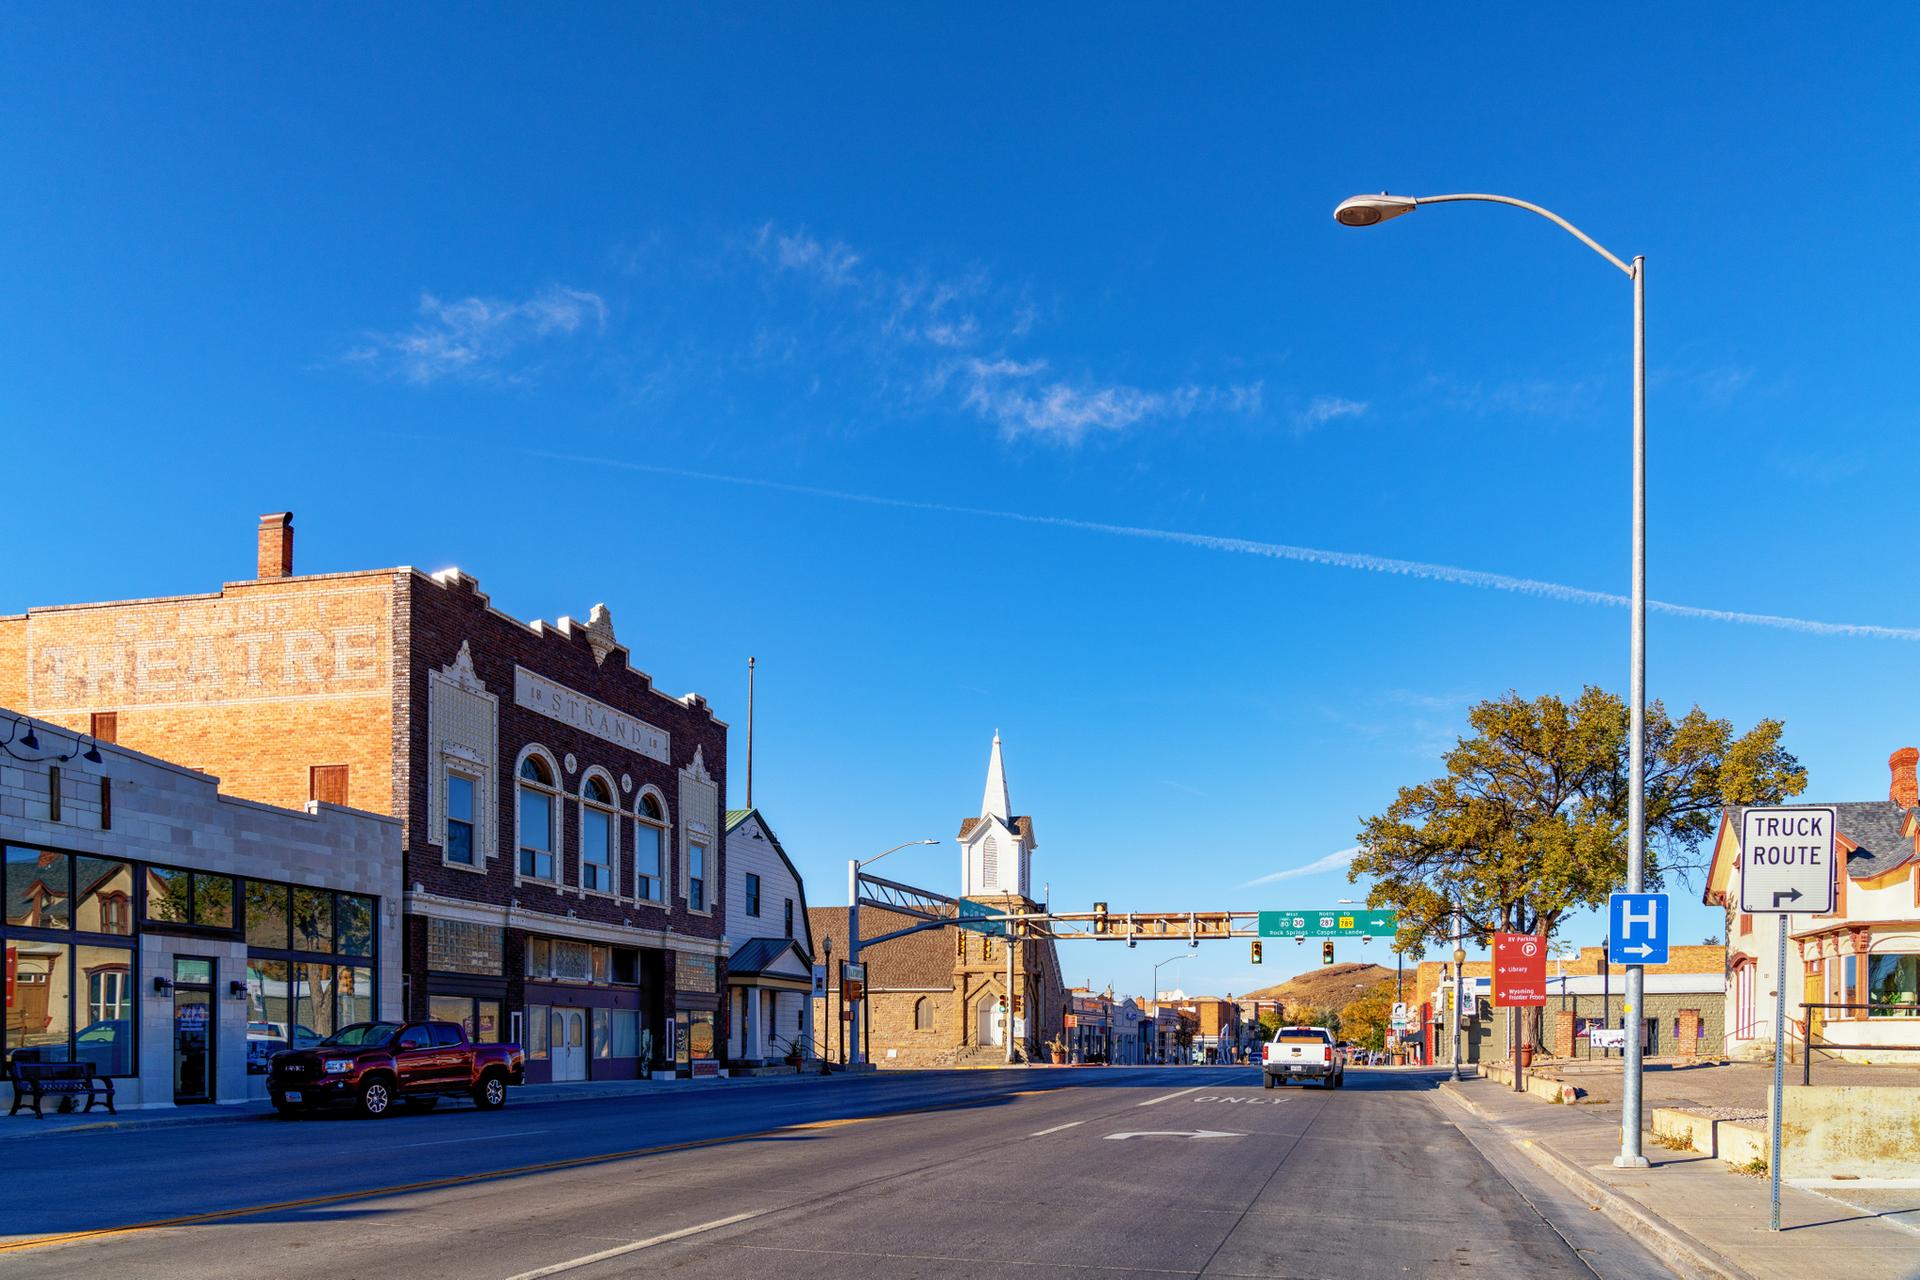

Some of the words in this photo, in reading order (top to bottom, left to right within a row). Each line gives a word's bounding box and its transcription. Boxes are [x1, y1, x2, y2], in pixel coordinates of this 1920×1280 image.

[41, 624, 379, 699] THEATRE
[551, 691, 642, 745] STRAND
[1755, 817, 1823, 837] TRUCK
[1754, 846, 1822, 866] ROUTE
[1622, 899, 1657, 940] H
